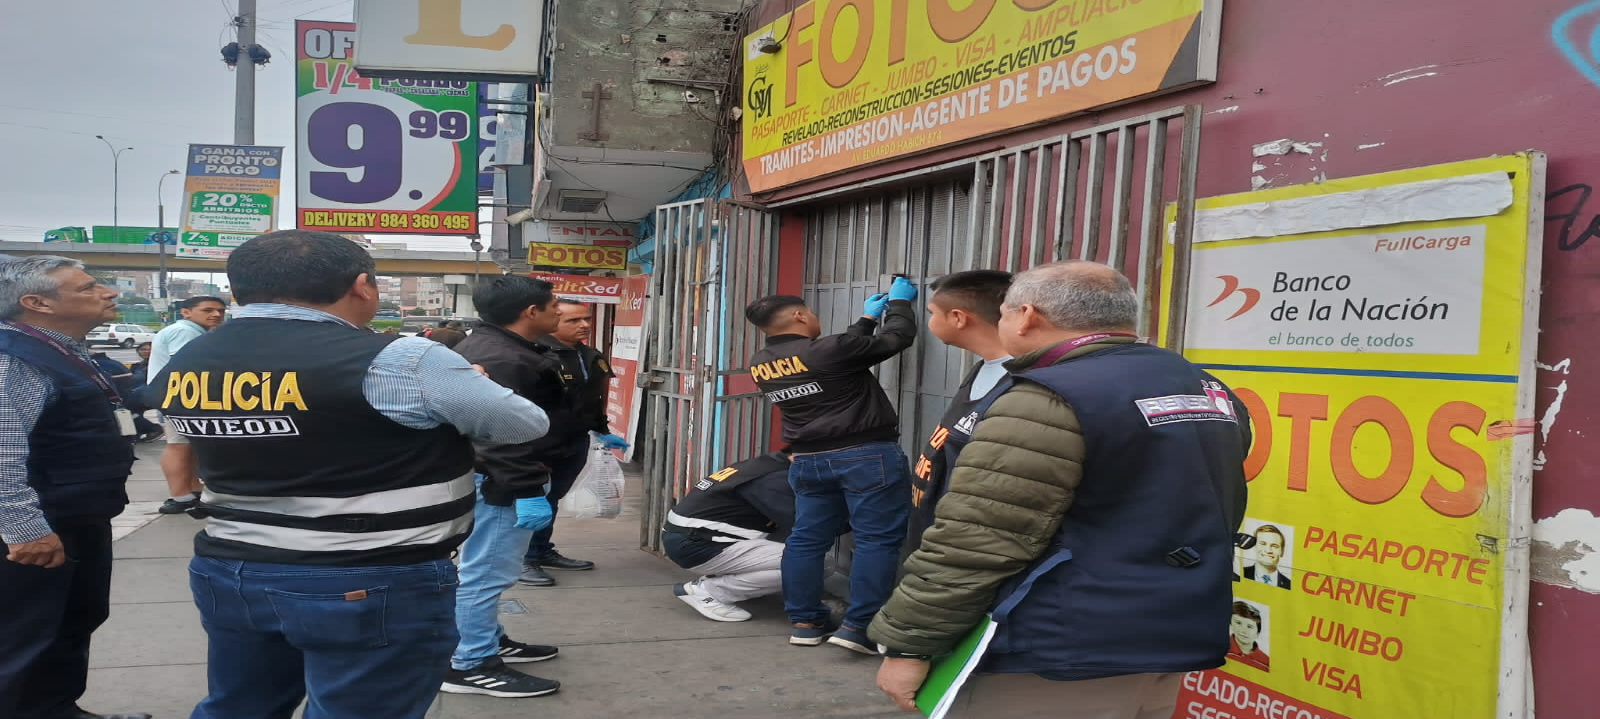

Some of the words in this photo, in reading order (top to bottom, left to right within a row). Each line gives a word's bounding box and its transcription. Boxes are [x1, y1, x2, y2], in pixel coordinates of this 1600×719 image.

[998, 72, 1029, 109] DE
[1037, 37, 1137, 97] PAGOS
[751, 105, 811, 140] PASAPORTE
[821, 82, 871, 116] CARNET
[882, 56, 937, 95] JUMBO
[955, 34, 996, 70] VISA
[194, 155, 278, 167] PRONTO
[202, 148, 246, 156] GANA
[205, 165, 260, 175] PAGO
[201, 193, 238, 207] 20
[304, 211, 377, 229] DELIVERY
[380, 213, 408, 230] 984
[412, 213, 439, 230] 360
[442, 214, 470, 231] 495
[1375, 235, 1471, 253] FullCarga
[530, 246, 623, 266] FOTOS
[535, 274, 565, 282] Agente
[552, 281, 619, 295] ultiRed
[1273, 272, 1351, 293] Banco
[1270, 300, 1299, 321] de
[1308, 298, 1332, 321] la
[1341, 296, 1449, 321] Nación
[1268, 332, 1281, 345] el
[1287, 332, 1334, 347] banco
[1340, 332, 1360, 347] de
[1366, 332, 1415, 348] todos
[171, 418, 292, 436] DIVIEOD
[1303, 526, 1490, 585] PASAPORTE
[1301, 571, 1416, 617] CARNET
[1299, 616, 1403, 662] JUMBO
[1302, 657, 1362, 700] VISA
